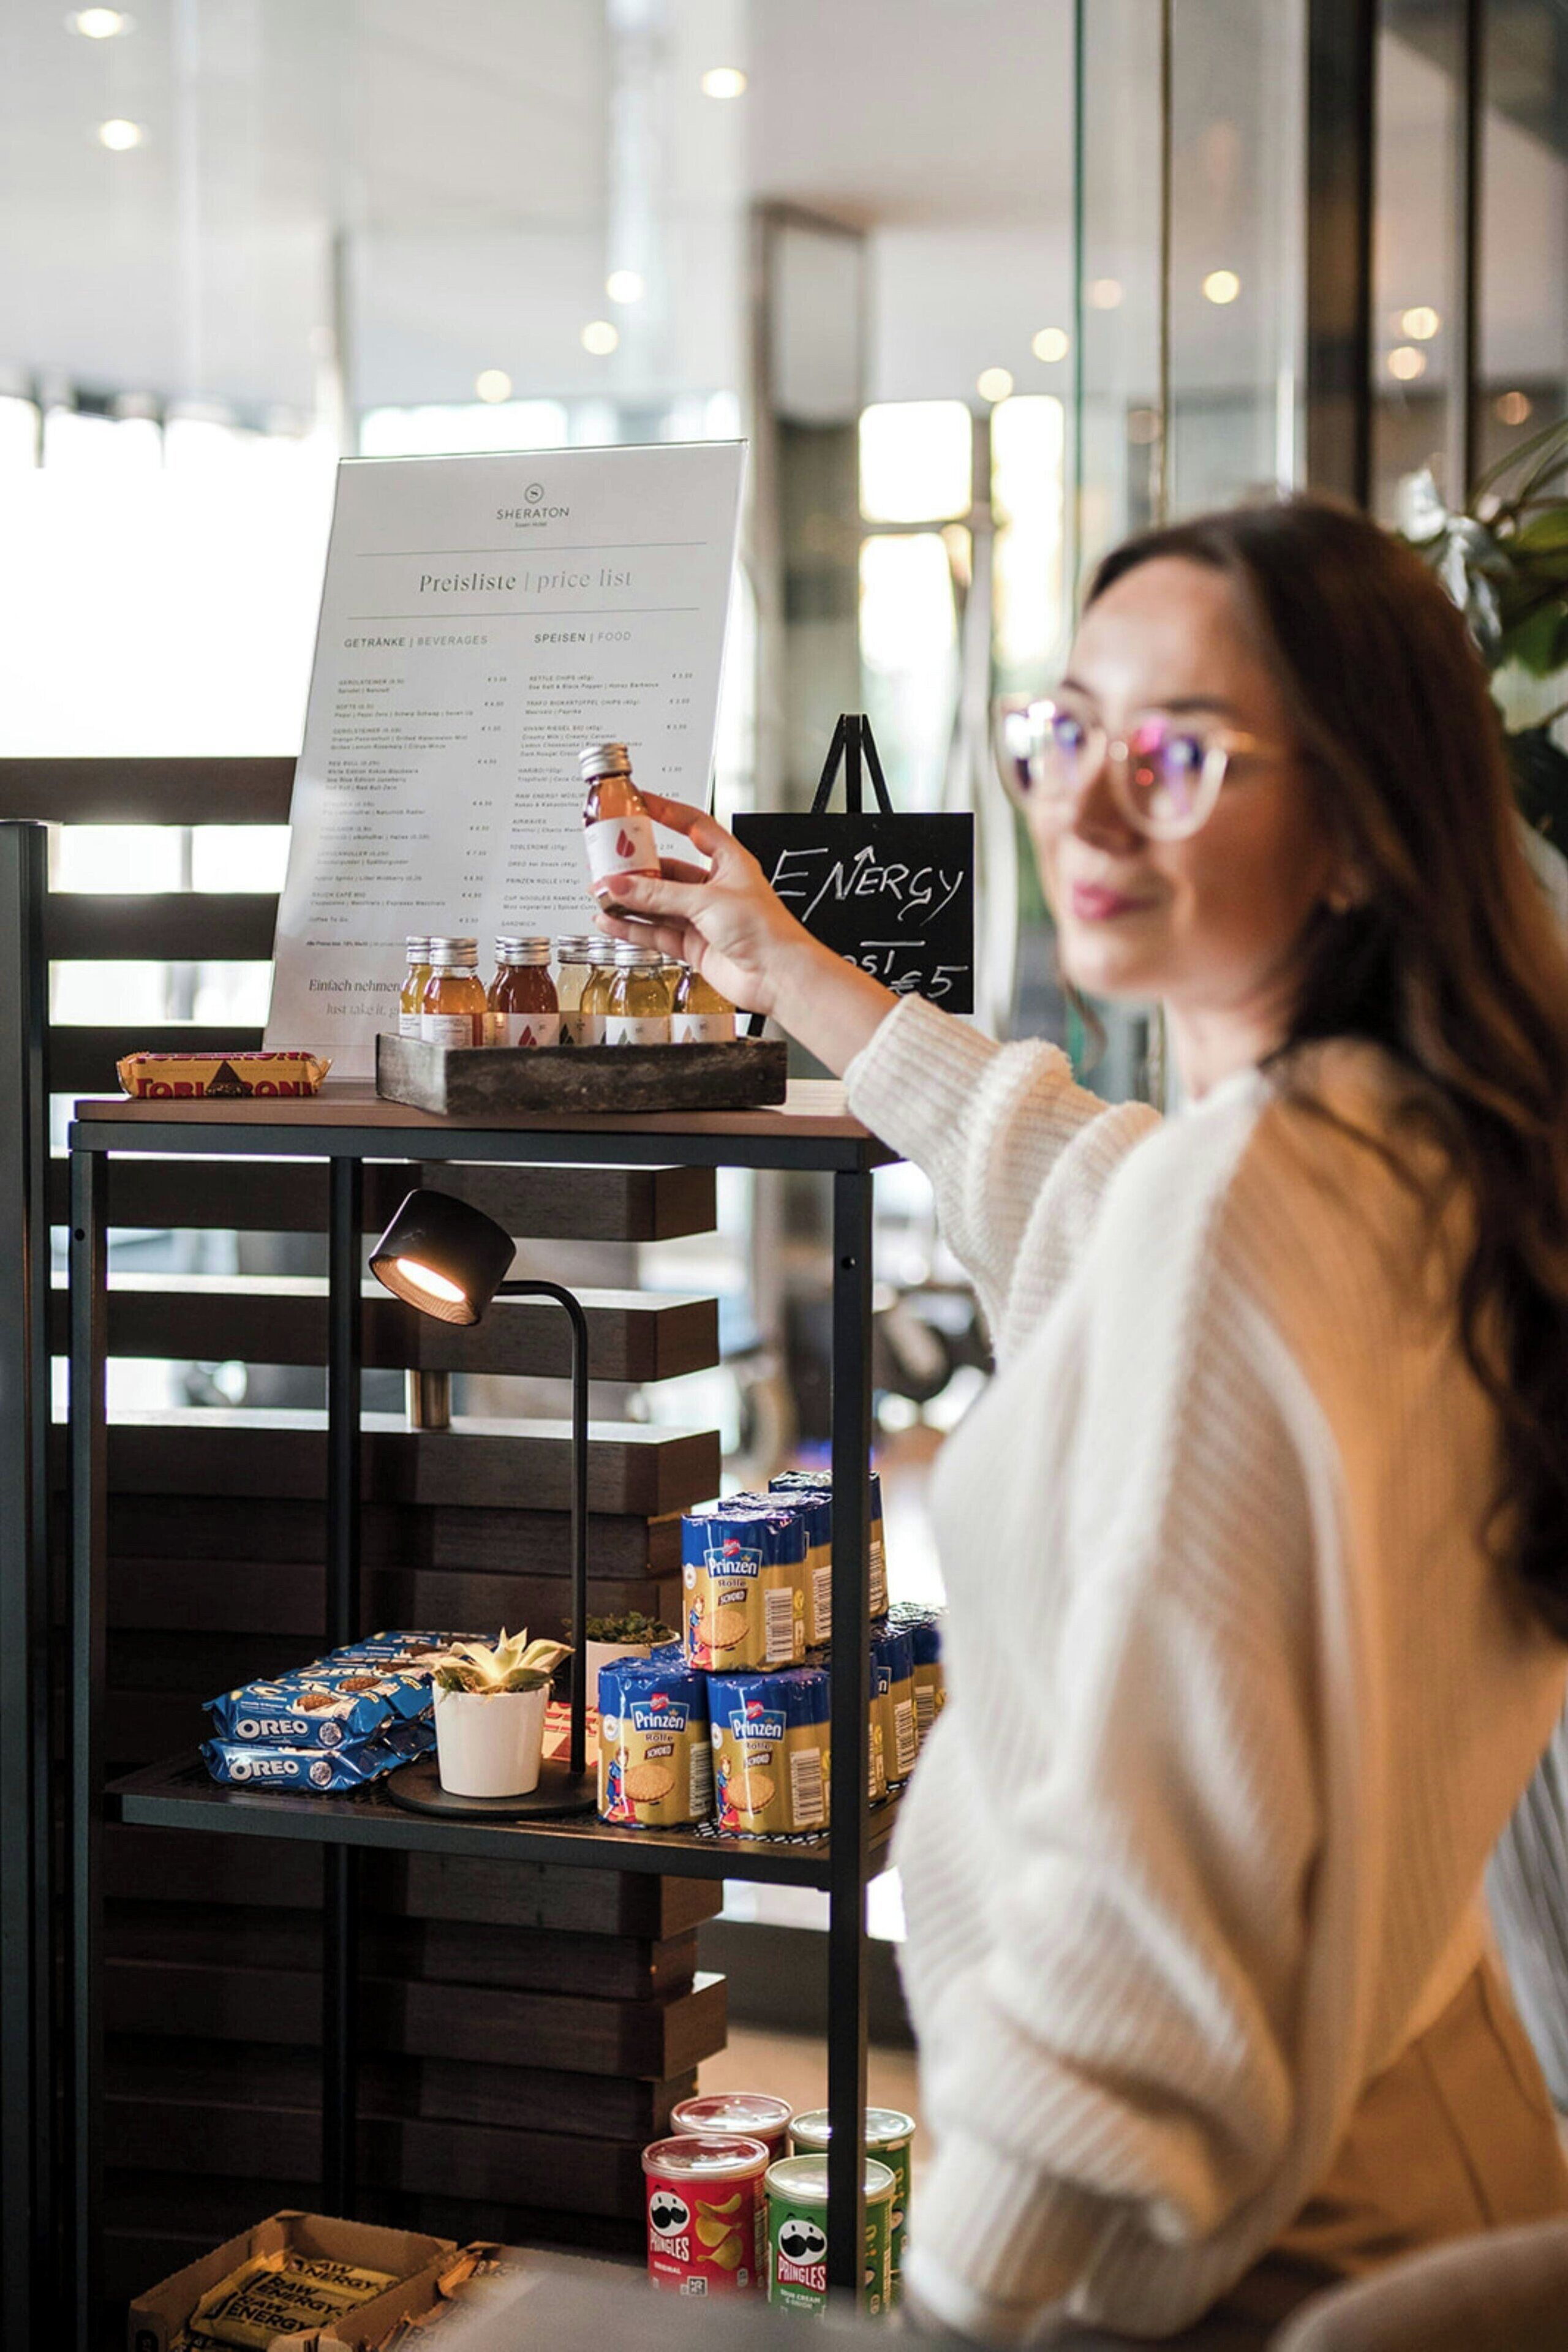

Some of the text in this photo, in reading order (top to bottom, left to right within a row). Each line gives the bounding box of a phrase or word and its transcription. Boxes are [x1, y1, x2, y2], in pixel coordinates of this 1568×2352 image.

[496, 507, 570, 521] SHERATON
[420, 568, 631, 593] Preisliste price list
[418, 635, 489, 646] BEVERAGES
[534, 630, 633, 644] SPEISEN FOOD
[770, 844, 964, 926] ENERGY
[309, 979, 352, 992] Einfach
[709, 1556, 757, 1575] Prinzen
[718, 1579, 746, 1588] Rolle
[235, 1718, 309, 1740] OREO
[635, 1709, 684, 1729] Prinzen
[733, 1718, 782, 1738] Prinzen
[646, 1733, 673, 1742] Rolle
[228, 1760, 300, 1782] OREO
[649, 2227, 689, 2262] PRINGLES
[777, 2255, 826, 2291] PRINGLES
[268, 2275, 320, 2296] RAW
[255, 2283, 341, 2315] ENERGY
[227, 2301, 314, 2332] ENERGY
